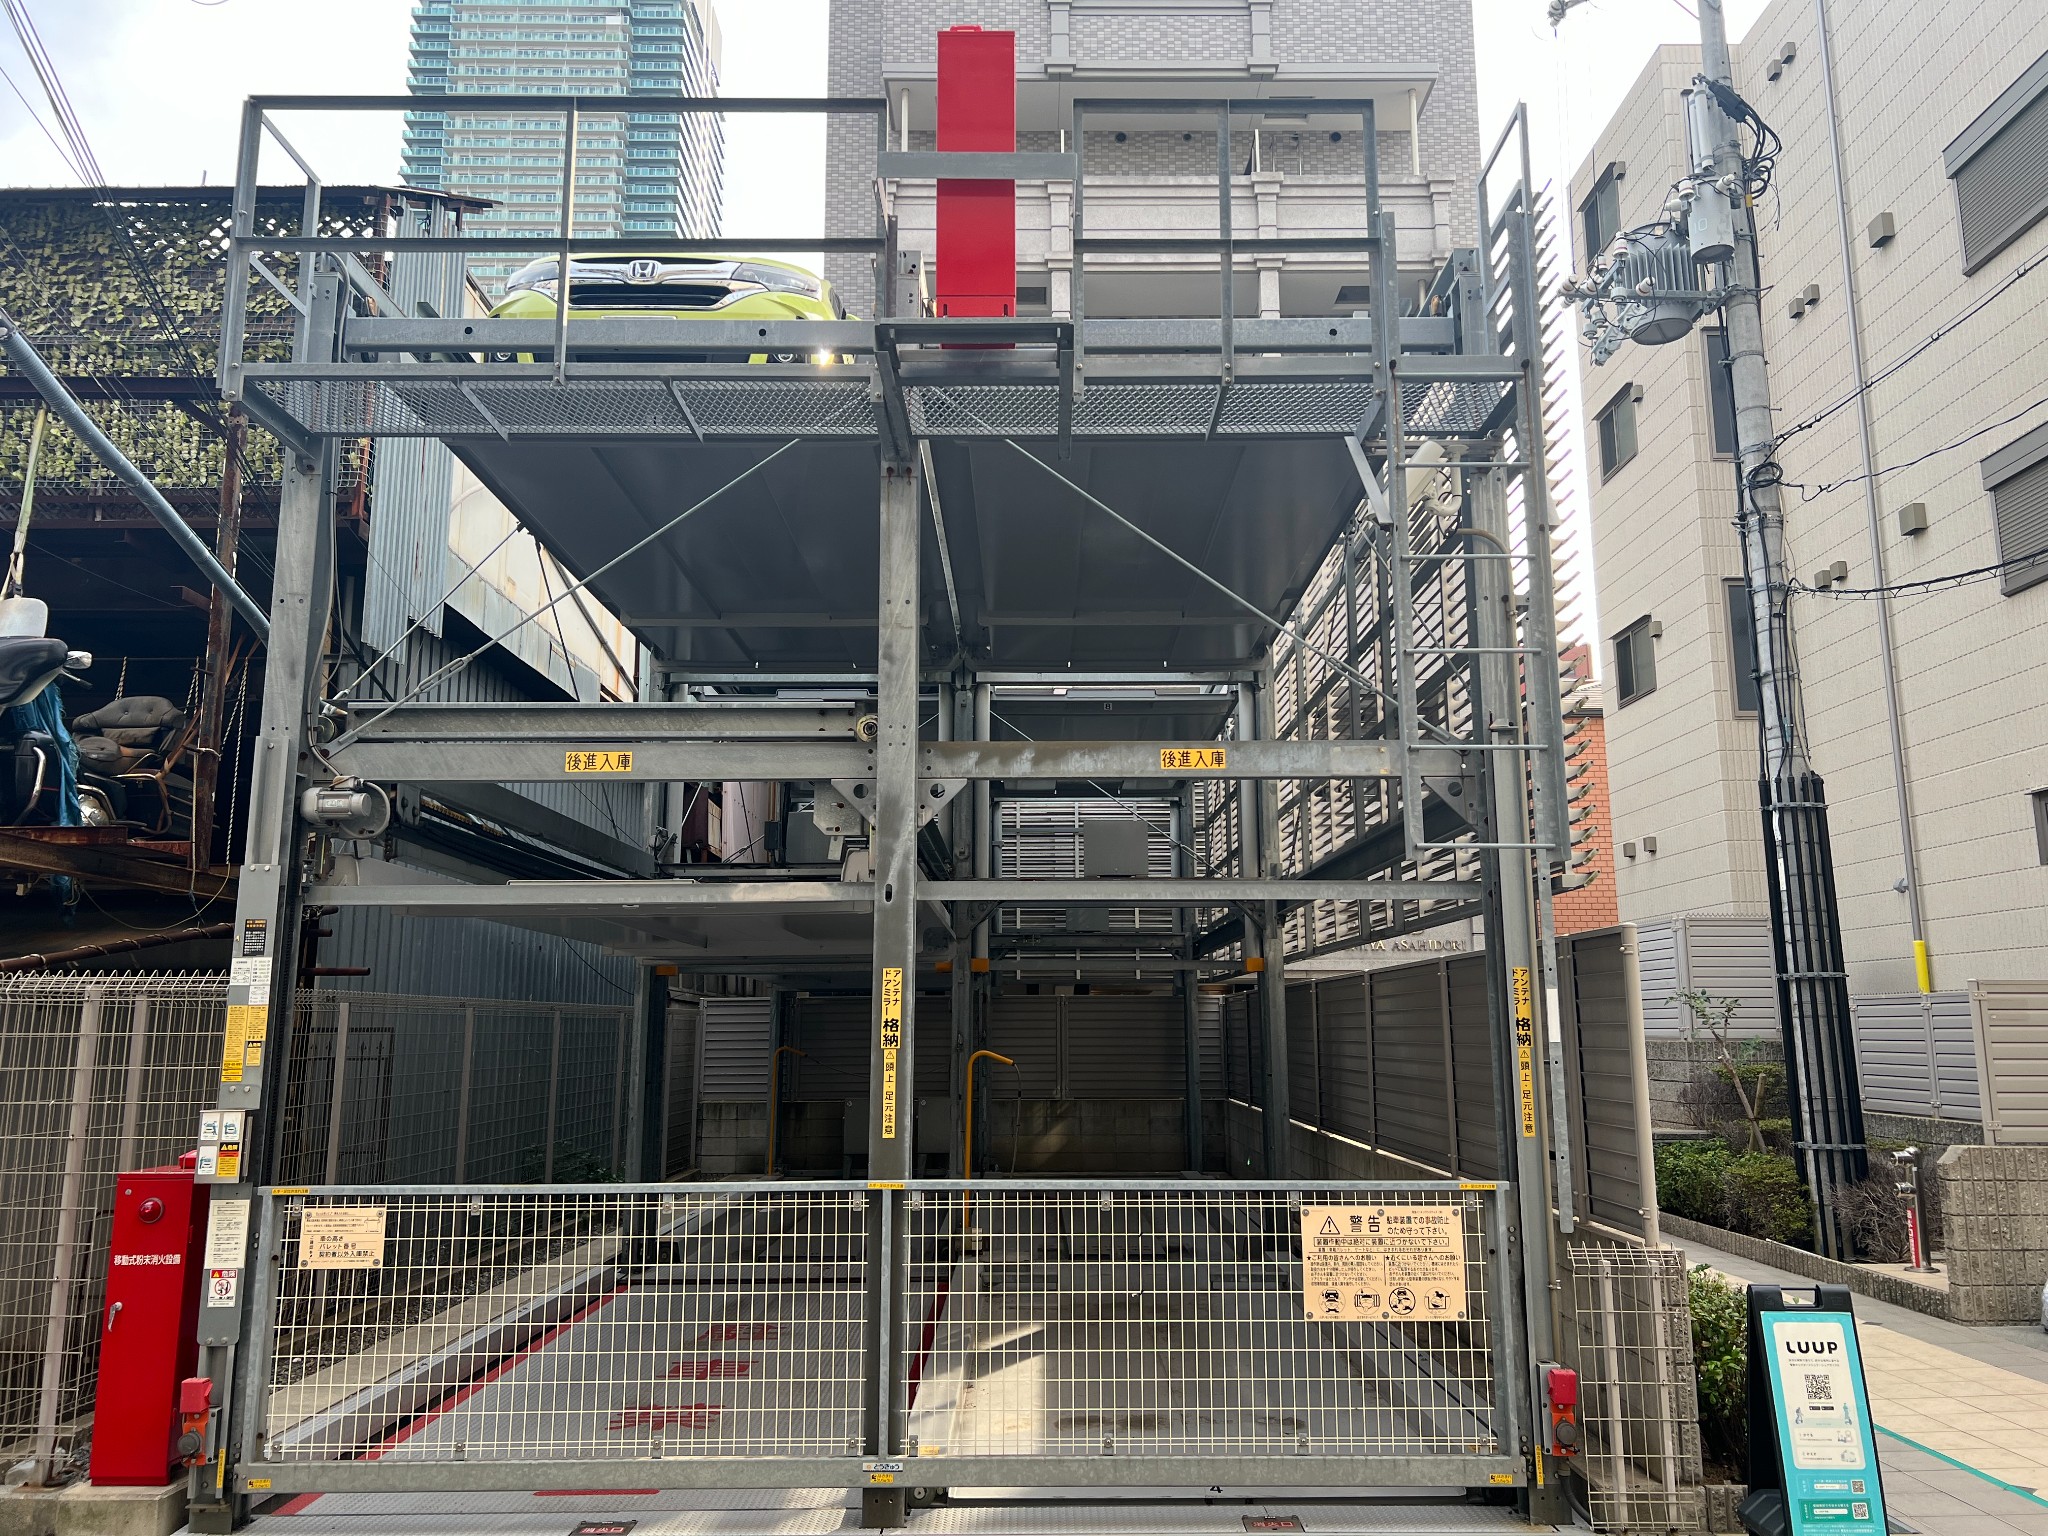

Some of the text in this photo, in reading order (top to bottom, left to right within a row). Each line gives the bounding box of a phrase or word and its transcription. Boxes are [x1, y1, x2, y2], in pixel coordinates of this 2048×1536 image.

[567, 753, 631, 771] 後進入庫
[1162, 750, 1224, 768] 後進入庫
[1392, 939, 1466, 951] ASAHIDORI
[884, 970, 892, 1016] ドアミラー
[892, 969, 901, 1006] アンテナ
[1512, 968, 1520, 1015] ドアミラー
[1520, 968, 1530, 1006] アンテナ
[882, 1017, 900, 1048] 格納
[1515, 1016, 1532, 1047] 格納
[884, 1061, 894, 1135] 頭上・足元注意
[1520, 1061, 1534, 1134] 頭上・足元注意
[1349, 1215, 1381, 1233] 警告
[1387, 1216, 1450, 1225] 駐車装置での事故防止
[319, 1242, 357, 1250] パレット番号
[113, 1254, 181, 1266] 移動式粉末消火設備
[1786, 1341, 1838, 1354] LUUP
